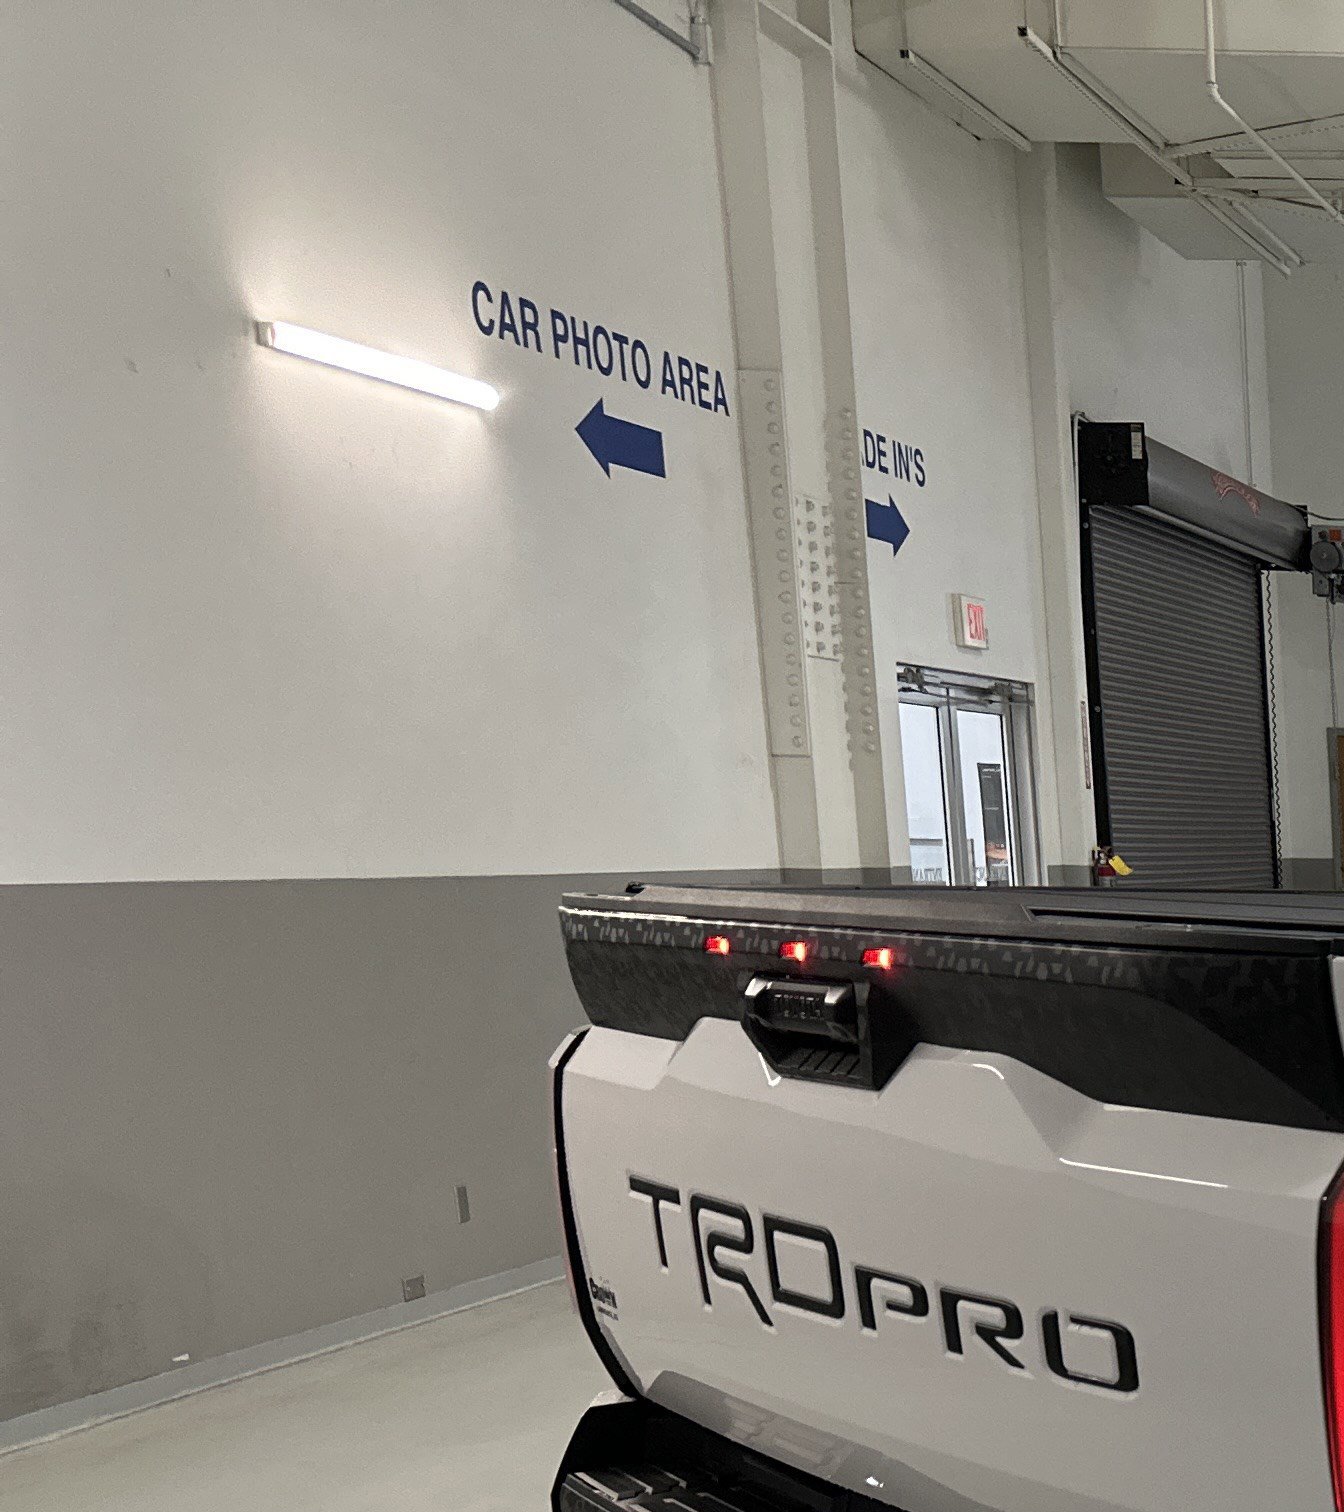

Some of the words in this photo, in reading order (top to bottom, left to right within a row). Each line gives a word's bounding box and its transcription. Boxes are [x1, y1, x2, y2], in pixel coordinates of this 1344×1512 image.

[471, 280, 543, 354] CAR
[550, 308, 651, 390] PHOTO
[661, 350, 730, 417] AREA
[860, 428, 889, 475] DE
[892, 439, 926, 488] IN'S
[967, 603, 986, 641] EXIT
